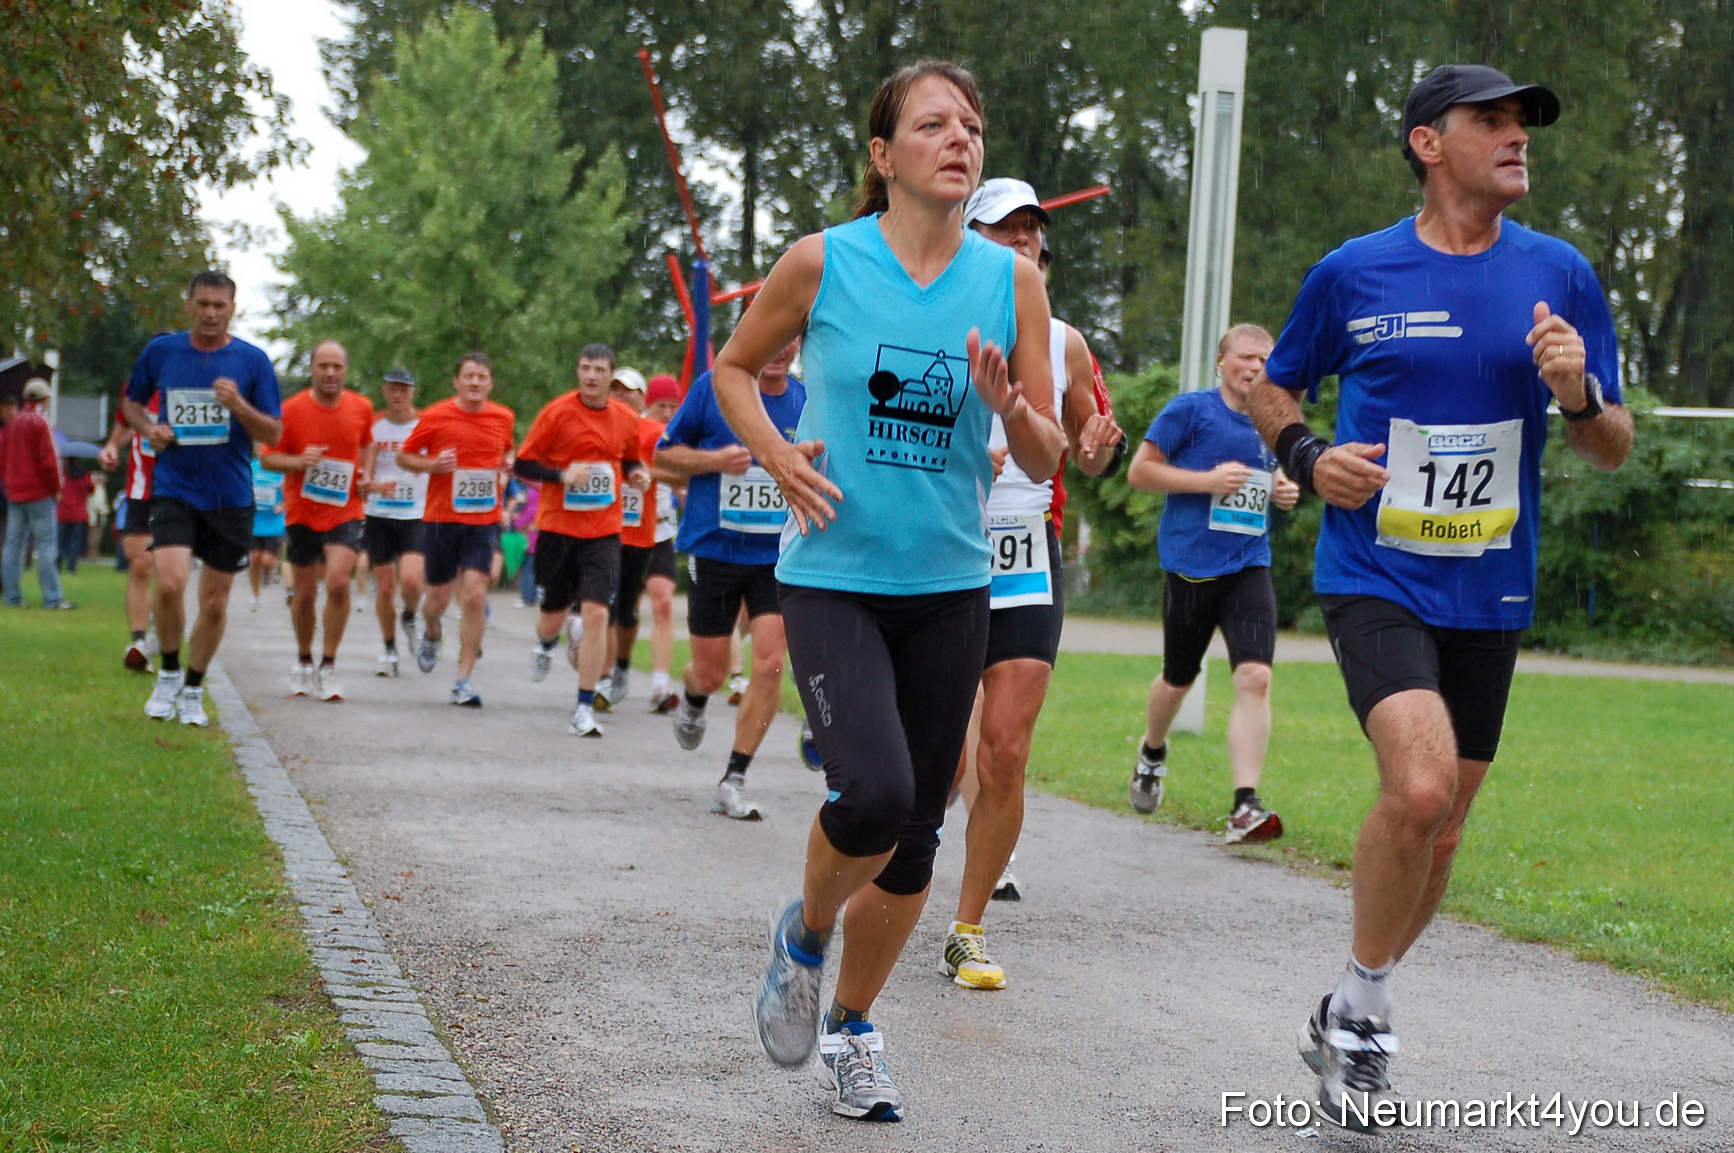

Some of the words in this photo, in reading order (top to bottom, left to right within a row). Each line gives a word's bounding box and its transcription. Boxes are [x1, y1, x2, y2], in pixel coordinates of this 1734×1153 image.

[174, 404, 223, 424] 2313
[867, 420, 952, 449] HIRSCH
[1428, 433, 1488, 448] BOCK
[310, 468, 348, 491] 2343
[458, 481, 493, 497] 2398
[1418, 459, 1495, 509] 142
[728, 484, 784, 509] 2153
[1420, 519, 1483, 539] Robert
[991, 532, 1033, 570] 91
